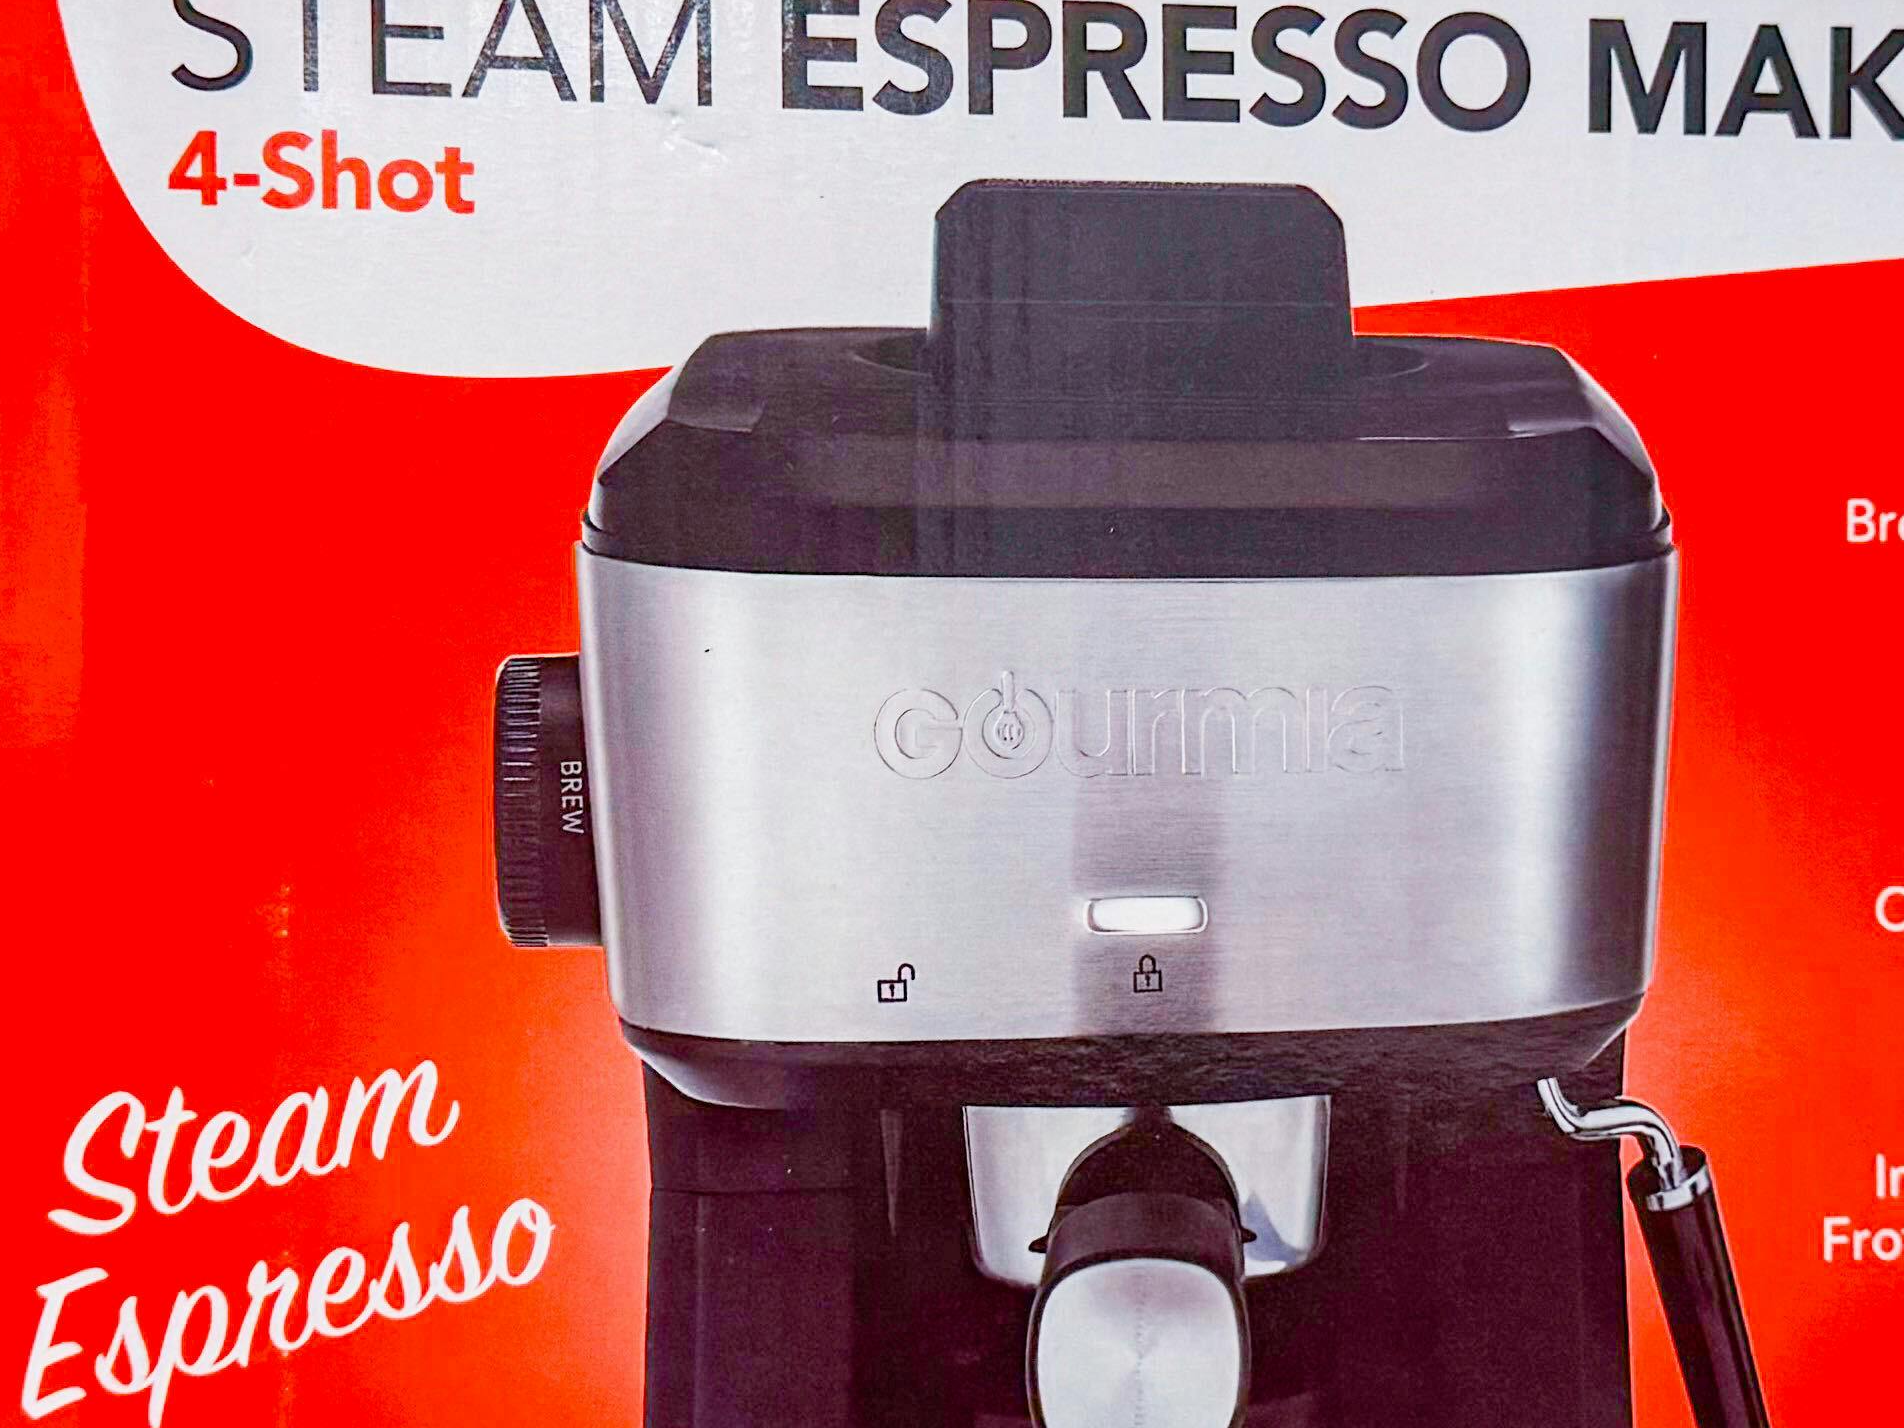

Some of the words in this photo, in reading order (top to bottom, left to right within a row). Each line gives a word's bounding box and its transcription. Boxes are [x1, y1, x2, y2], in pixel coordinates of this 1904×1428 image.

[165, 129, 475, 216] 4-Shot
[872, 670, 1404, 779] Gourmia
[560, 760, 584, 834] BREW
[47, 1059, 460, 1235] Steam
